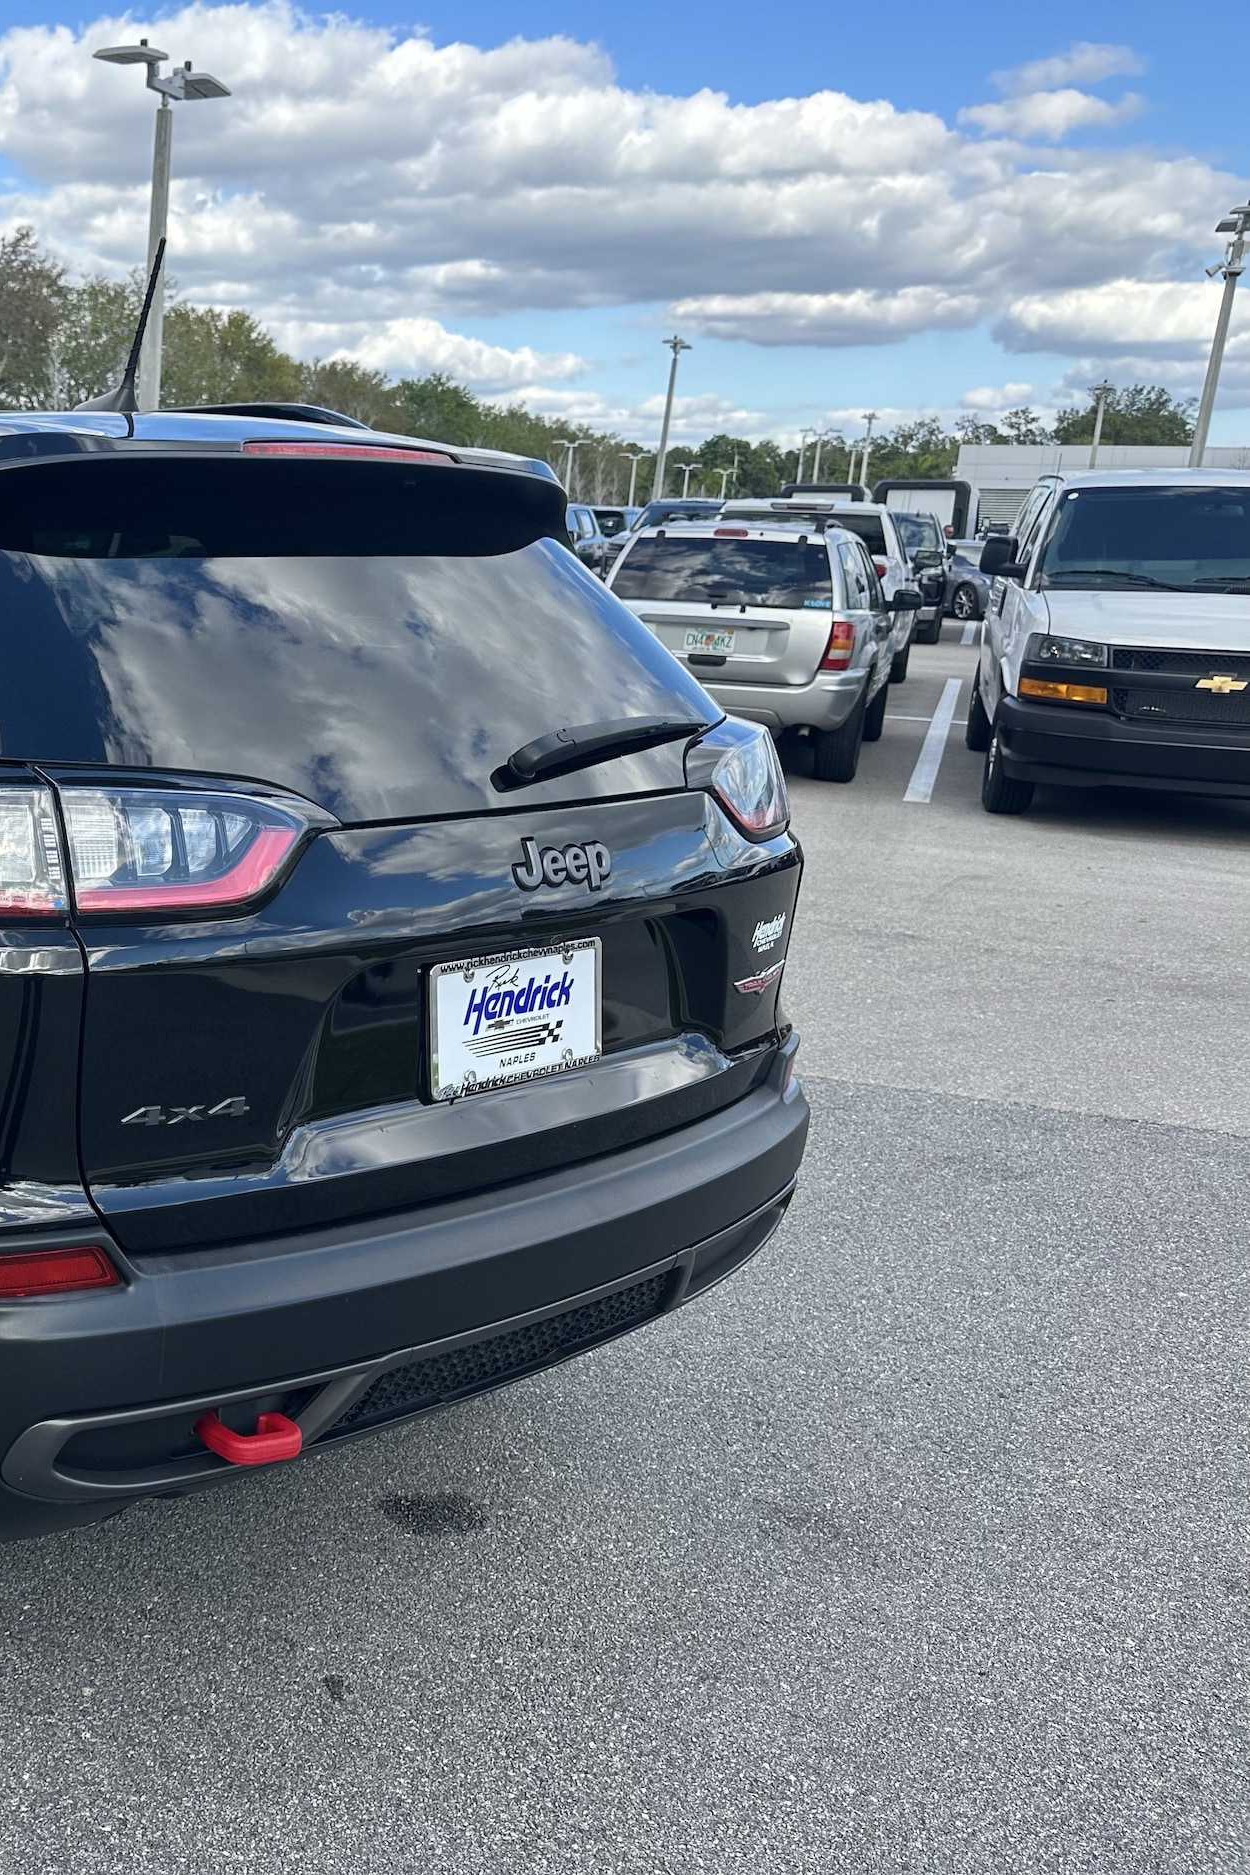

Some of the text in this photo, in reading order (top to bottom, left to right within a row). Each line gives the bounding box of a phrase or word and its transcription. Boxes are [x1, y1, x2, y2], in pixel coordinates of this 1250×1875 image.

[511, 836, 611, 892] Jeep
[463, 971, 574, 1035] Hendrick
[516, 1013, 550, 1025] CHEVROLET
[459, 1074, 507, 1098] Hendrick
[507, 1063, 563, 1084] CHEVROLET
[564, 1054, 600, 1070] NAPLES
[499, 1052, 536, 1069] NAPLES
[120, 1096, 250, 1126] 4x4
